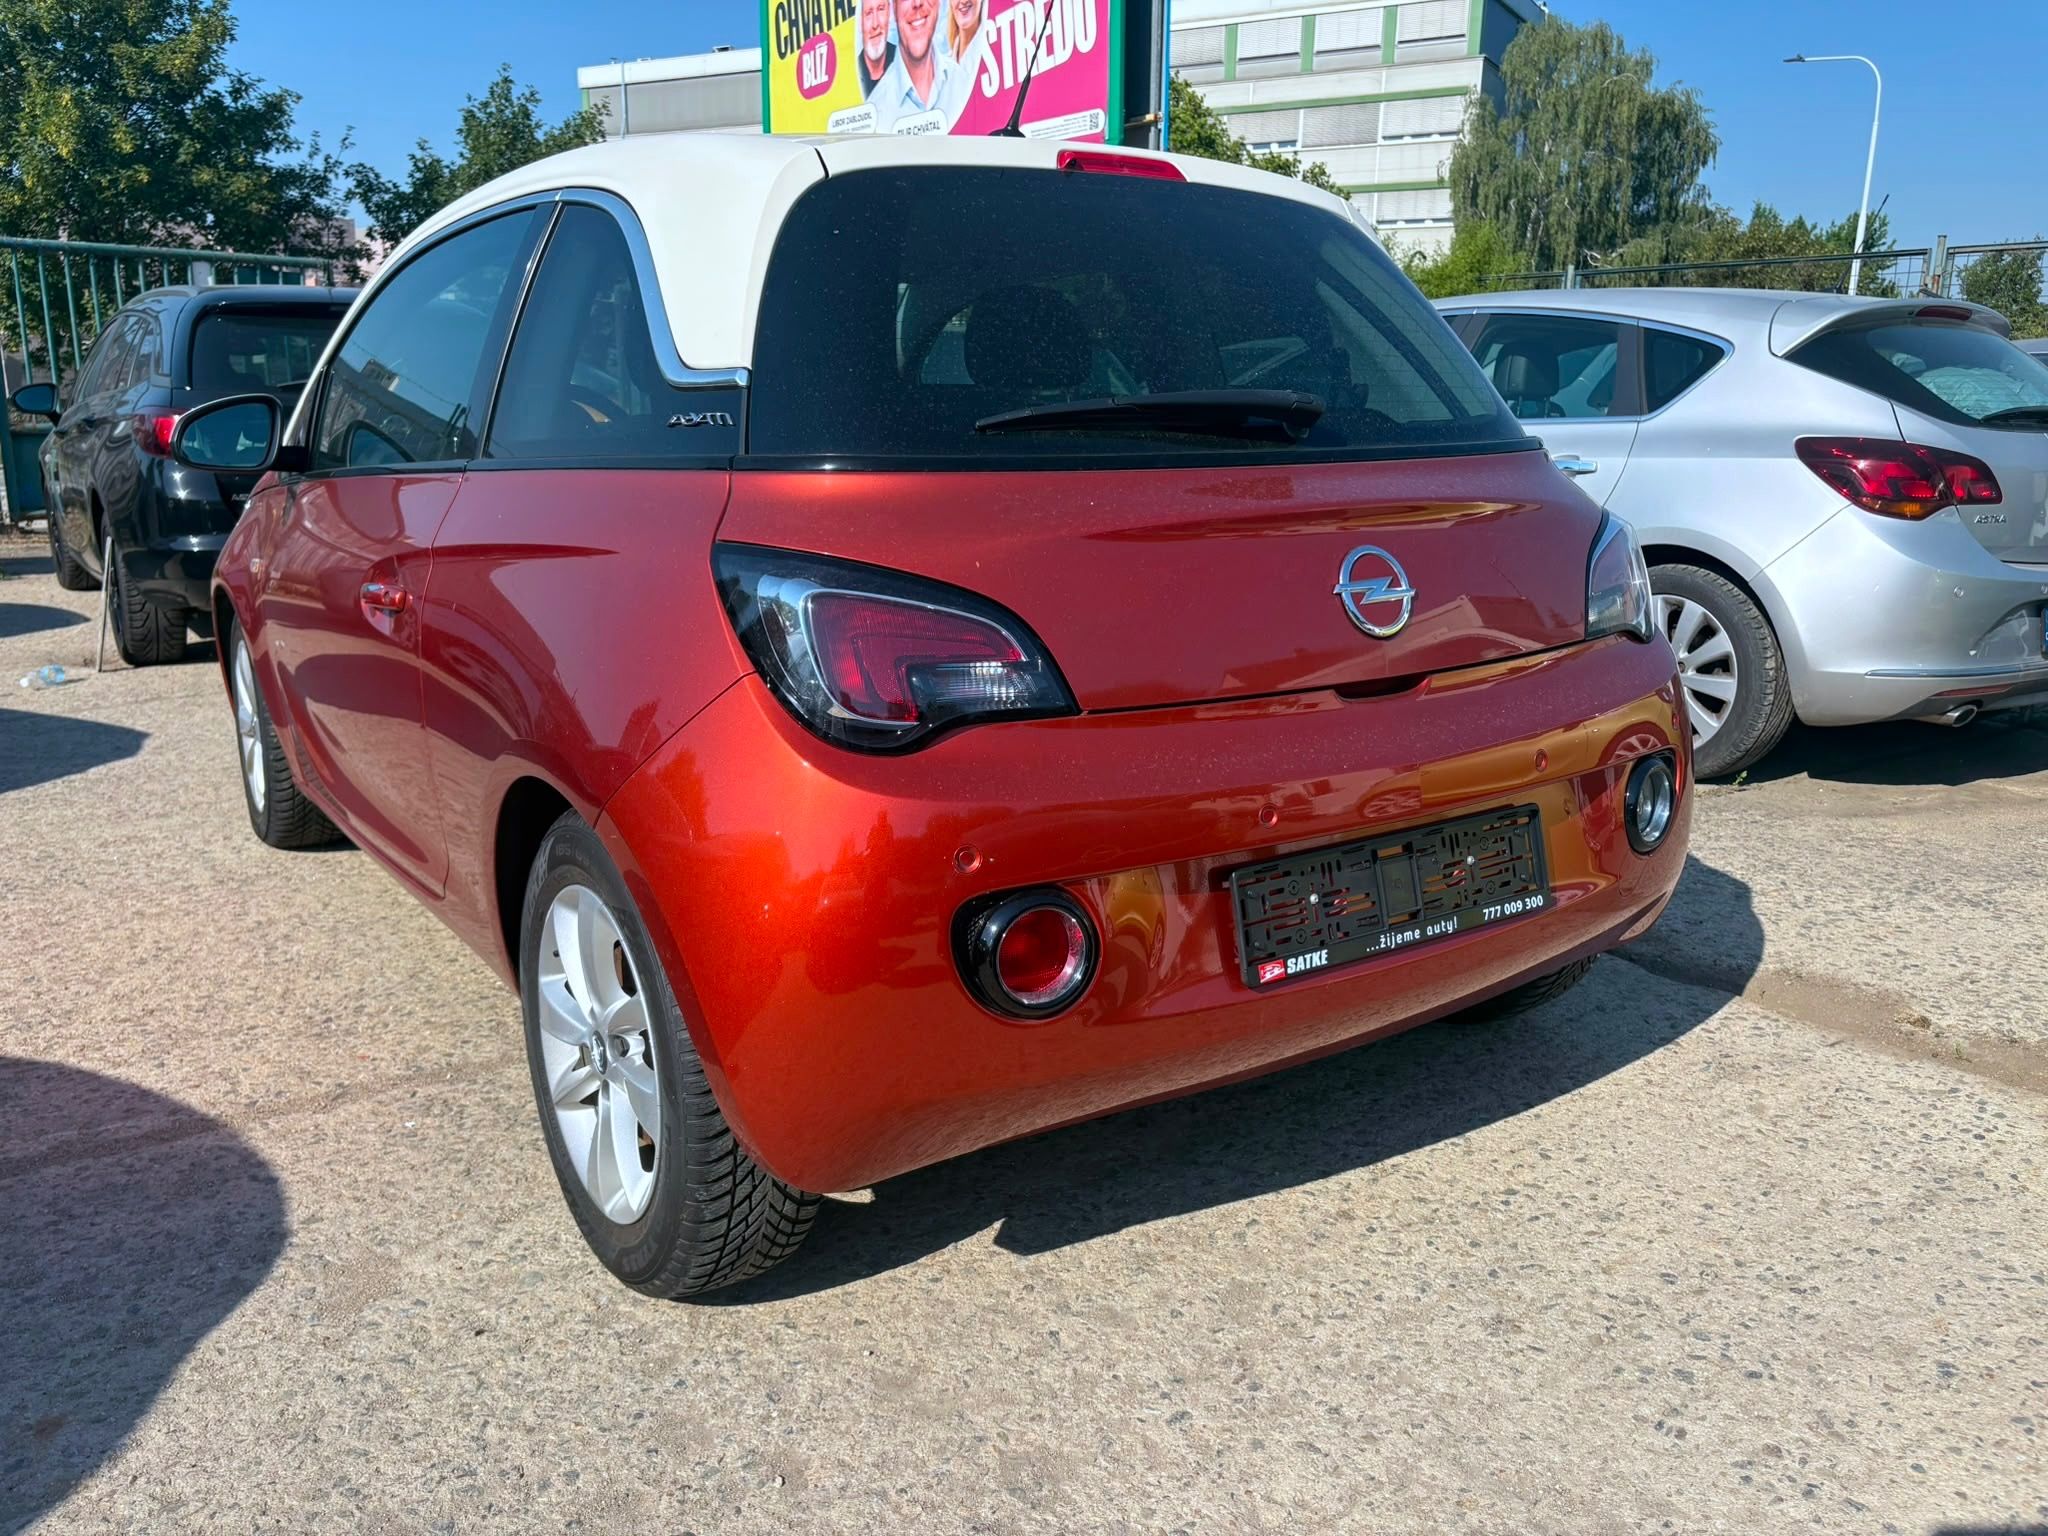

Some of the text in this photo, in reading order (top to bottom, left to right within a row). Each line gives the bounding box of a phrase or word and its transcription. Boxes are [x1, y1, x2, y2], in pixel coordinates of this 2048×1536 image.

[1974, 514, 2007, 524] ASTRA
[1482, 894, 1544, 921] 777 009 300
[1426, 916, 1458, 936] auty!
[1287, 949, 1329, 975] SATKE
